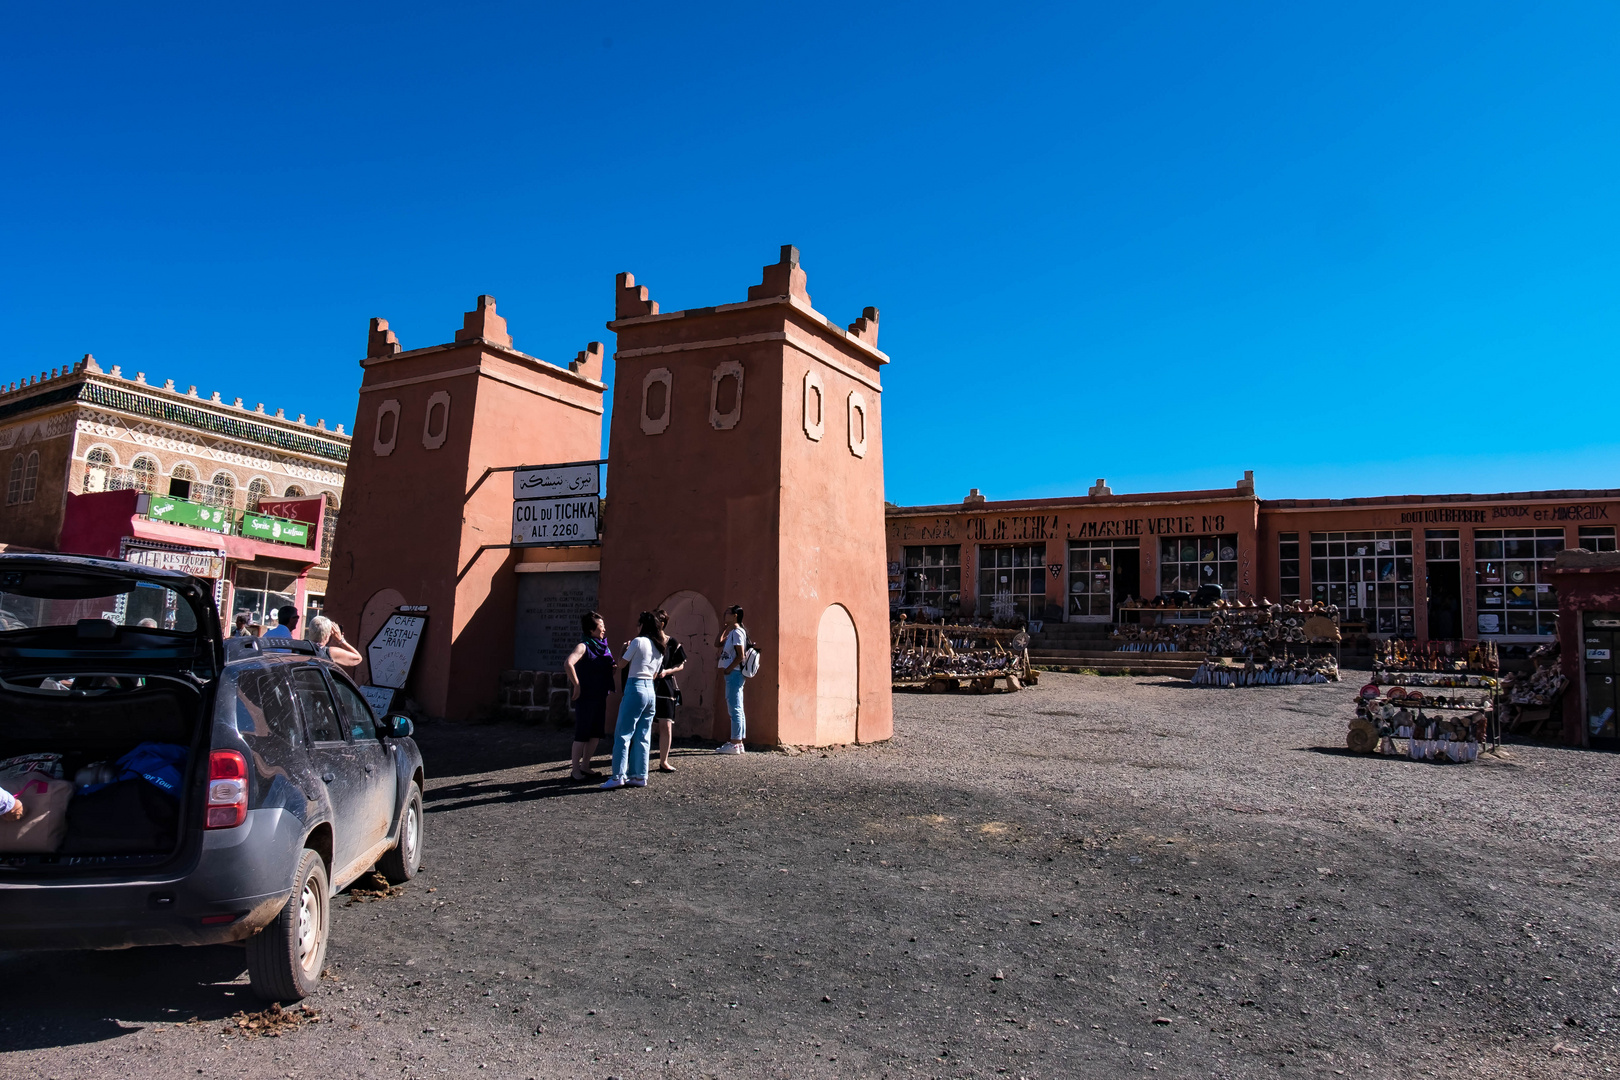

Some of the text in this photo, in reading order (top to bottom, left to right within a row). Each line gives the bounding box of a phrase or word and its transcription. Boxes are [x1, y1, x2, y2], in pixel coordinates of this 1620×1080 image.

[153, 502, 175, 516] Sprite
[516, 502, 596, 522] COL DU TICHKA
[251, 519, 270, 530] Sprite
[552, 523, 579, 537] 2260
[966, 517, 991, 540] COL
[1148, 516, 1195, 535] VERTE
[394, 616, 417, 626] CAFE
[155, 776, 174, 789] Tour
